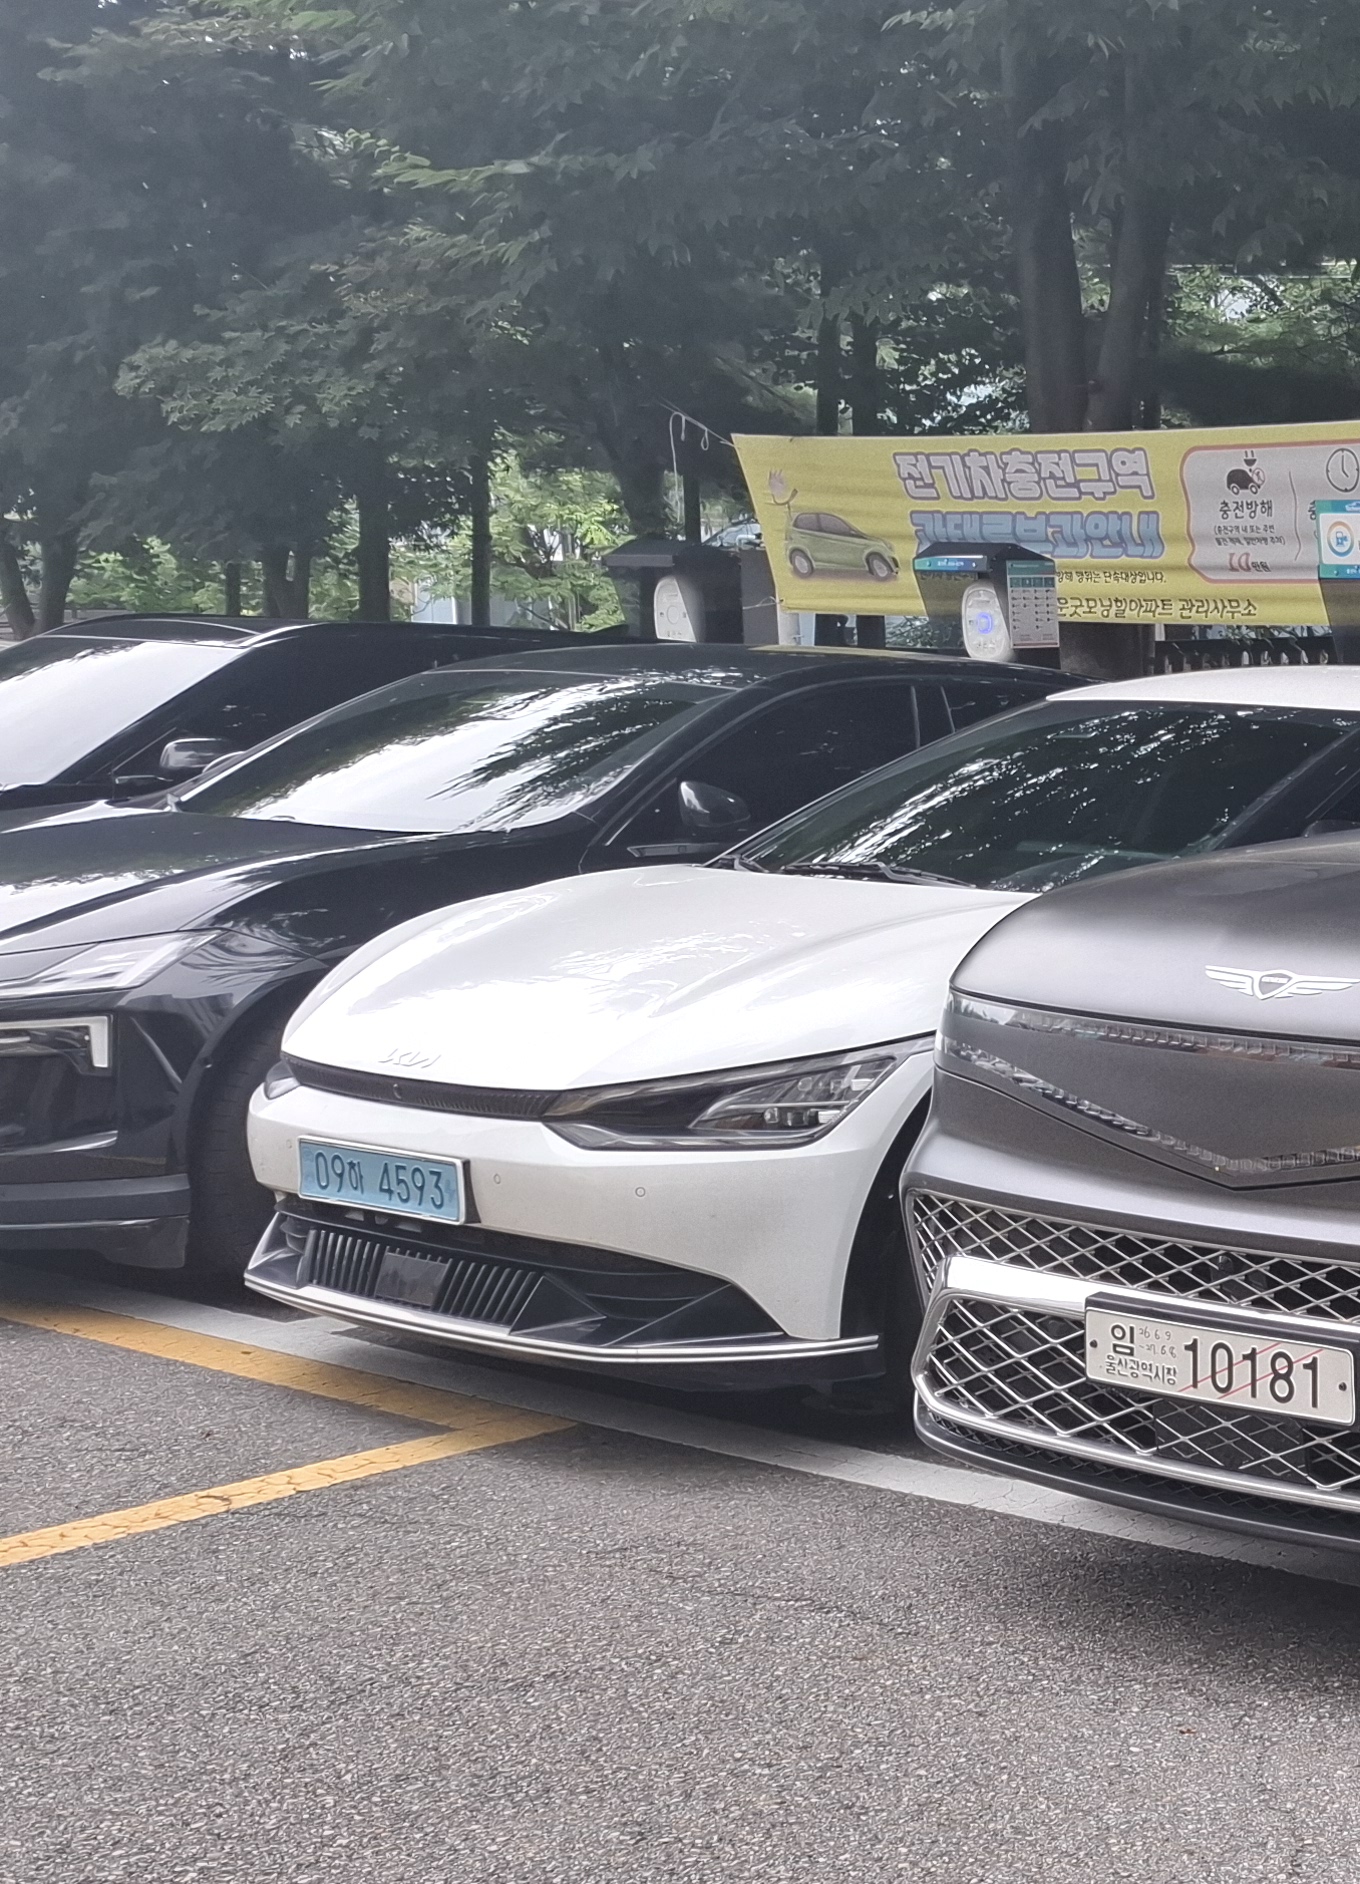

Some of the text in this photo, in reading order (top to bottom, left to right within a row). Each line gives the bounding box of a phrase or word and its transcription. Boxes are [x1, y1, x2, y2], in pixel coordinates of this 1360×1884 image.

[893, 447, 1156, 500] 전기차충전구역
[1219, 499, 1273, 520] 충전방해
[1103, 571, 1167, 584] 단속대상입니다.
[1178, 598, 1257, 620] 관리사무소
[314, 1151, 445, 1210] 09하 4593
[1110, 1323, 1135, 1357] 임
[1105, 1354, 1177, 1386] 울산광역시장
[1183, 1337, 1319, 1409] 10181
